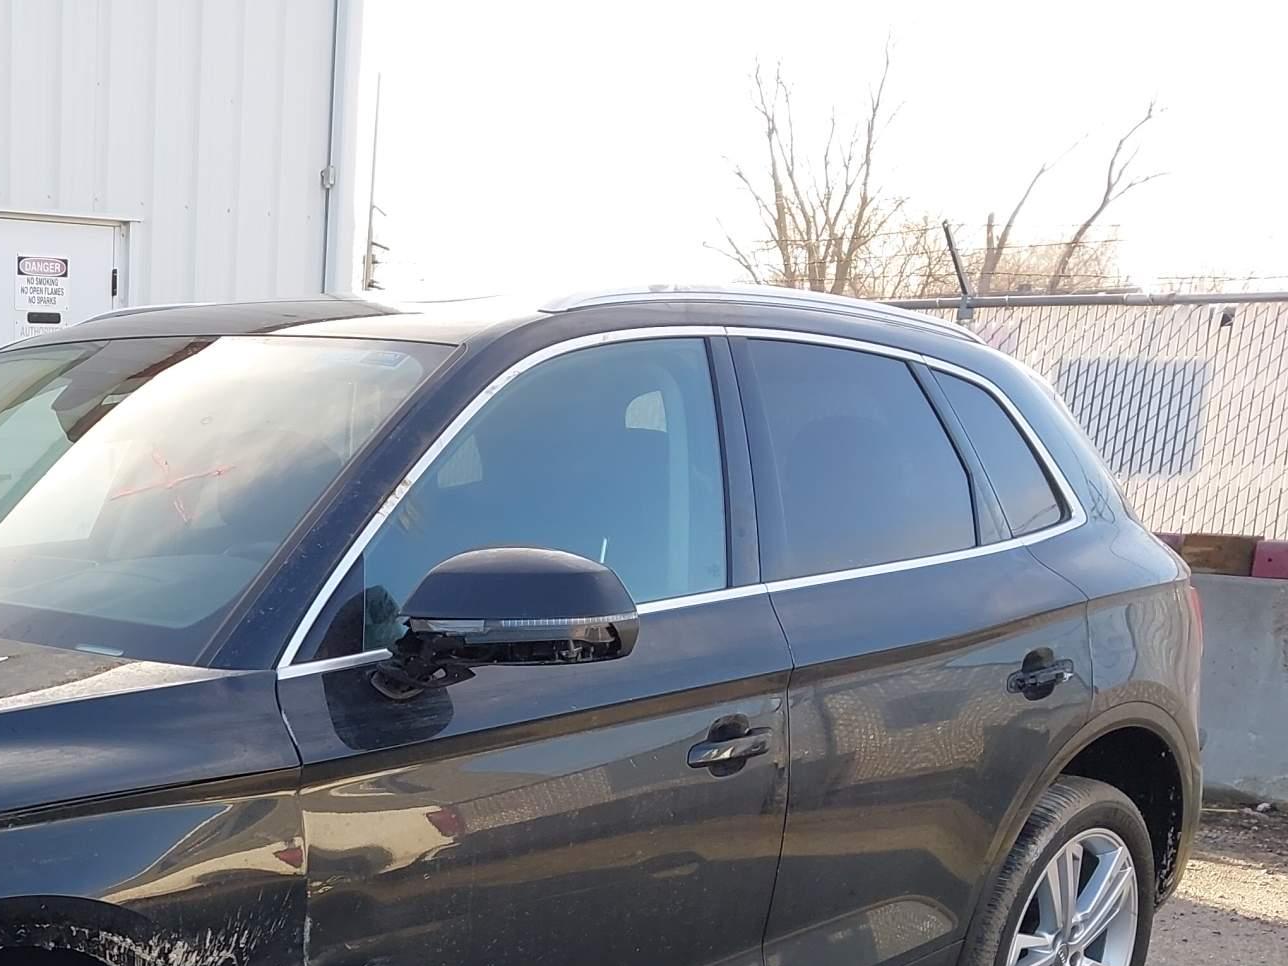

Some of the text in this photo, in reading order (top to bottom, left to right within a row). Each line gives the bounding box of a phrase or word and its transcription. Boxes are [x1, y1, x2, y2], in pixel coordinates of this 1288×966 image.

[24, 261, 61, 273] DANGER
[26, 277, 59, 287] NO SMOKING
[20, 286, 64, 297] NO OPEN FLAMES
[28, 295, 57, 305] NO SPARKS
